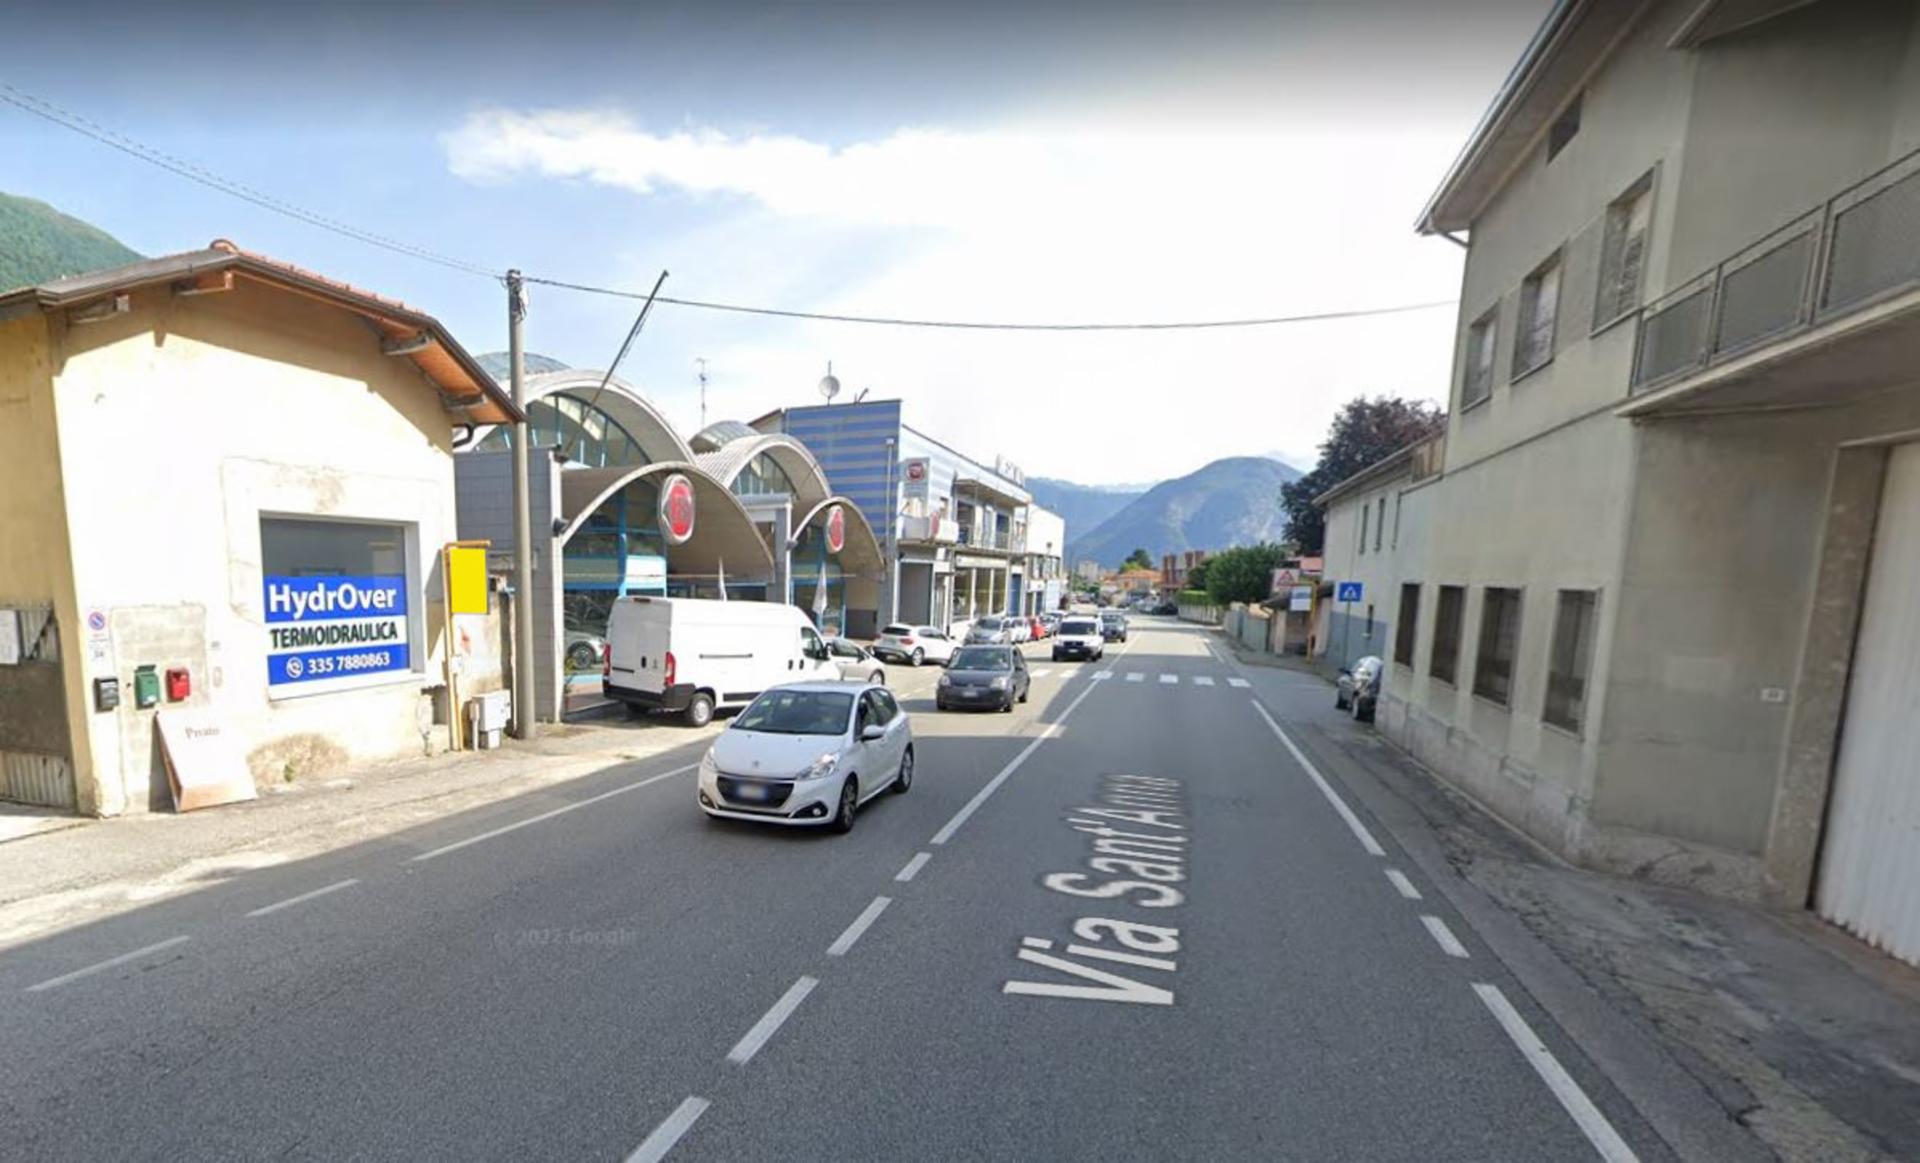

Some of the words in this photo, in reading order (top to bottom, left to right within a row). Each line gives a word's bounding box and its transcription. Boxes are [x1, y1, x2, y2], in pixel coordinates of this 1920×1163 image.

[269, 582, 397, 620] HydrOver
[269, 621, 398, 649] TERMOIDRAULICA
[307, 657, 334, 674] 335
